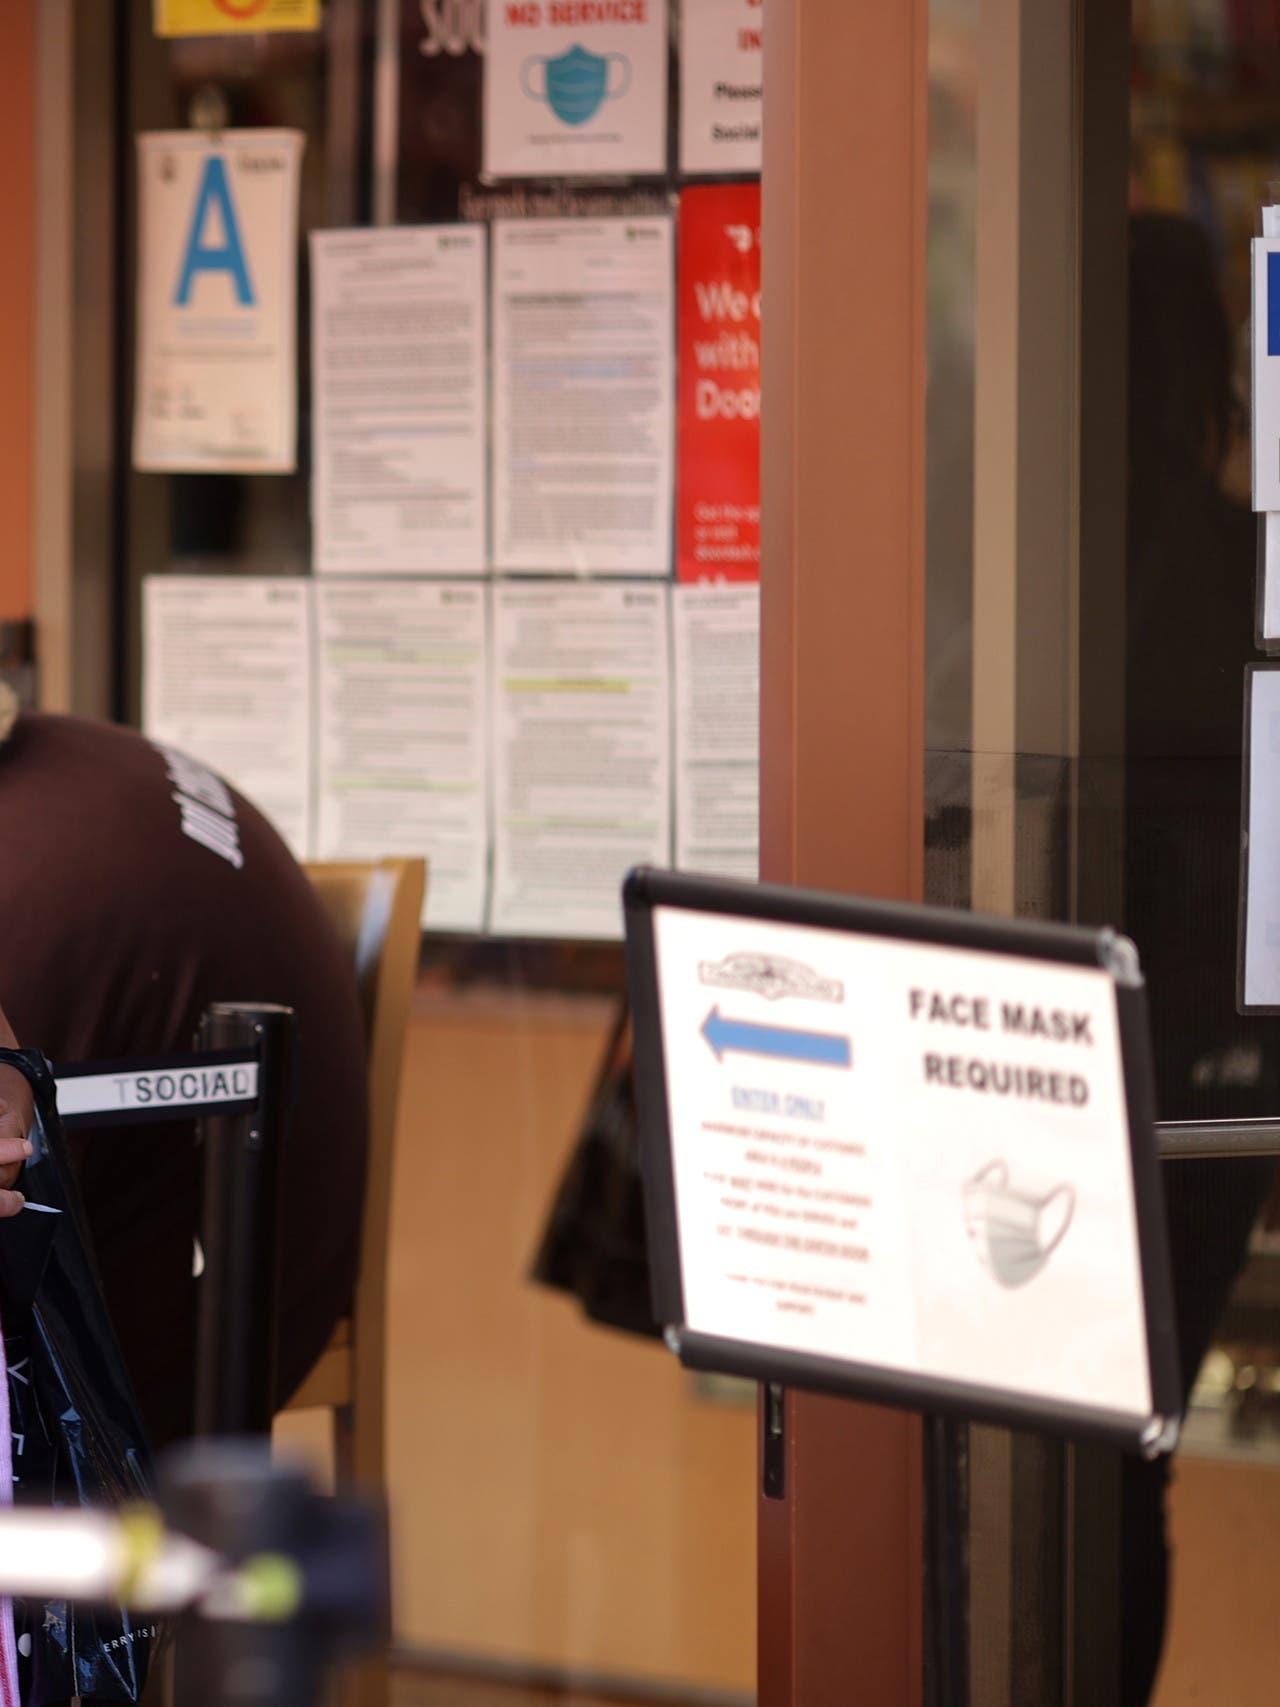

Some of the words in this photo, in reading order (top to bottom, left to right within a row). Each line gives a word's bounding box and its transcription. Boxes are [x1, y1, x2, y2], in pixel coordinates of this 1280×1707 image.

[548, 0, 648, 25] SERVICE
[172, 155, 257, 306] A
[695, 281, 749, 321] We
[909, 985, 991, 1031] FACE
[1000, 1000, 1094, 1047] MASK
[136, 1069, 247, 1103] SOCIAL
[924, 1053, 1089, 1108] REQUIRED
